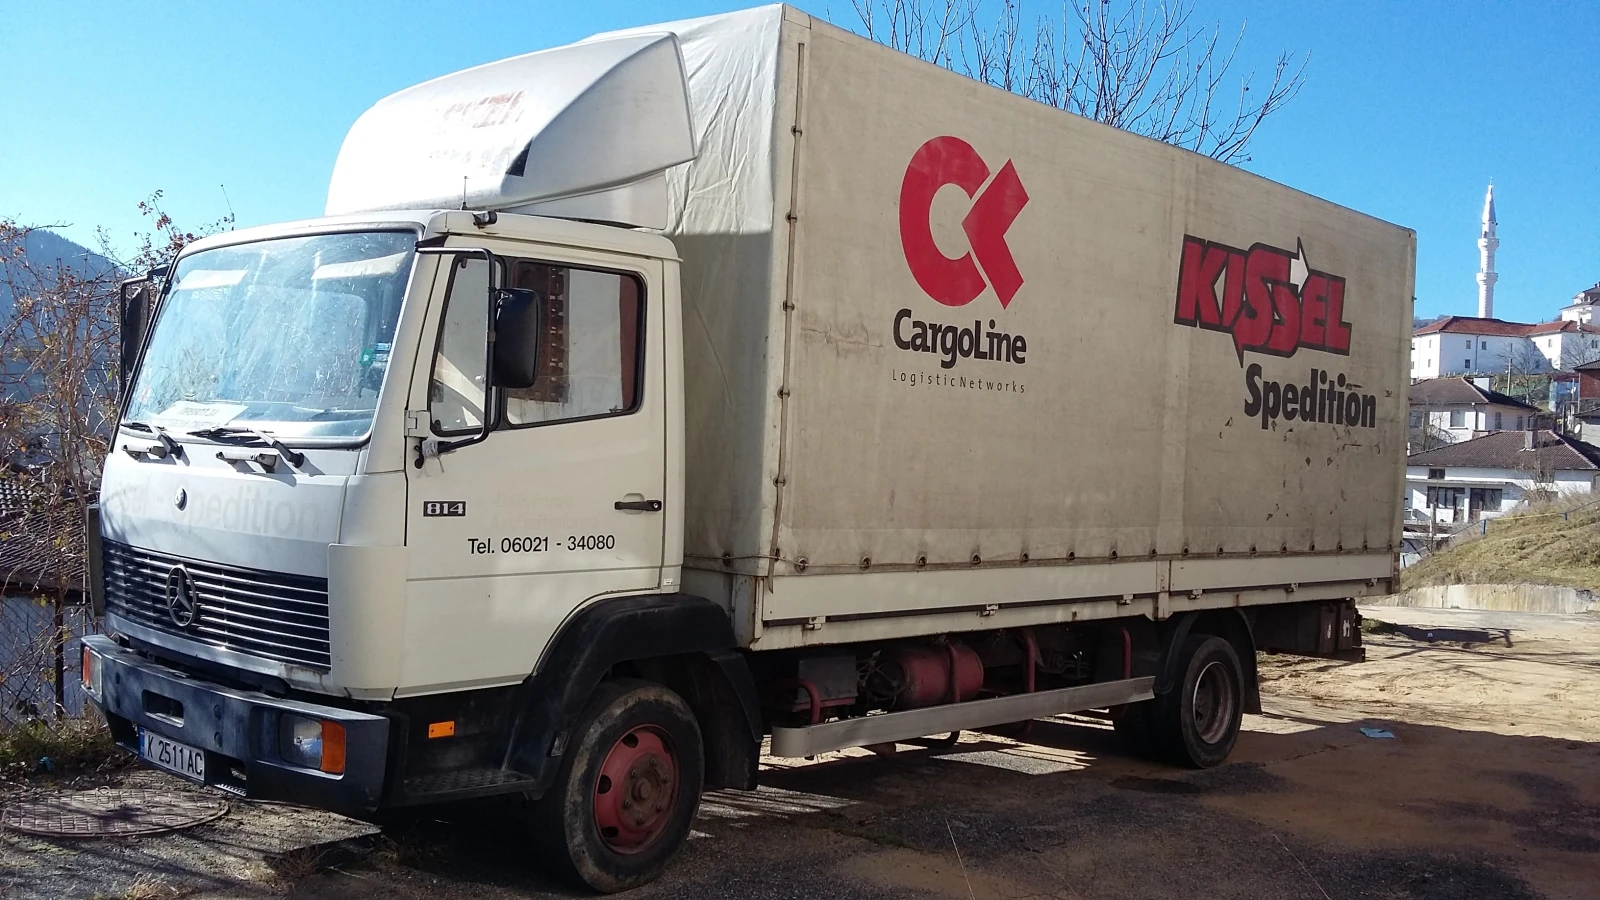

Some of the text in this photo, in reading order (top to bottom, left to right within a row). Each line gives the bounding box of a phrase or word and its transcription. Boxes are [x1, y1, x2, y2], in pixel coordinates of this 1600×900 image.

[1174, 234, 1352, 358] KISSEL
[893, 308, 1027, 369] CargoLine
[1244, 363, 1376, 429] Spedition
[426, 502, 464, 515] 814
[468, 538, 495, 554] Tel.
[501, 537, 549, 553] 06021
[567, 535, 616, 551] 34080
[147, 735, 203, 776] K 2511 AC
